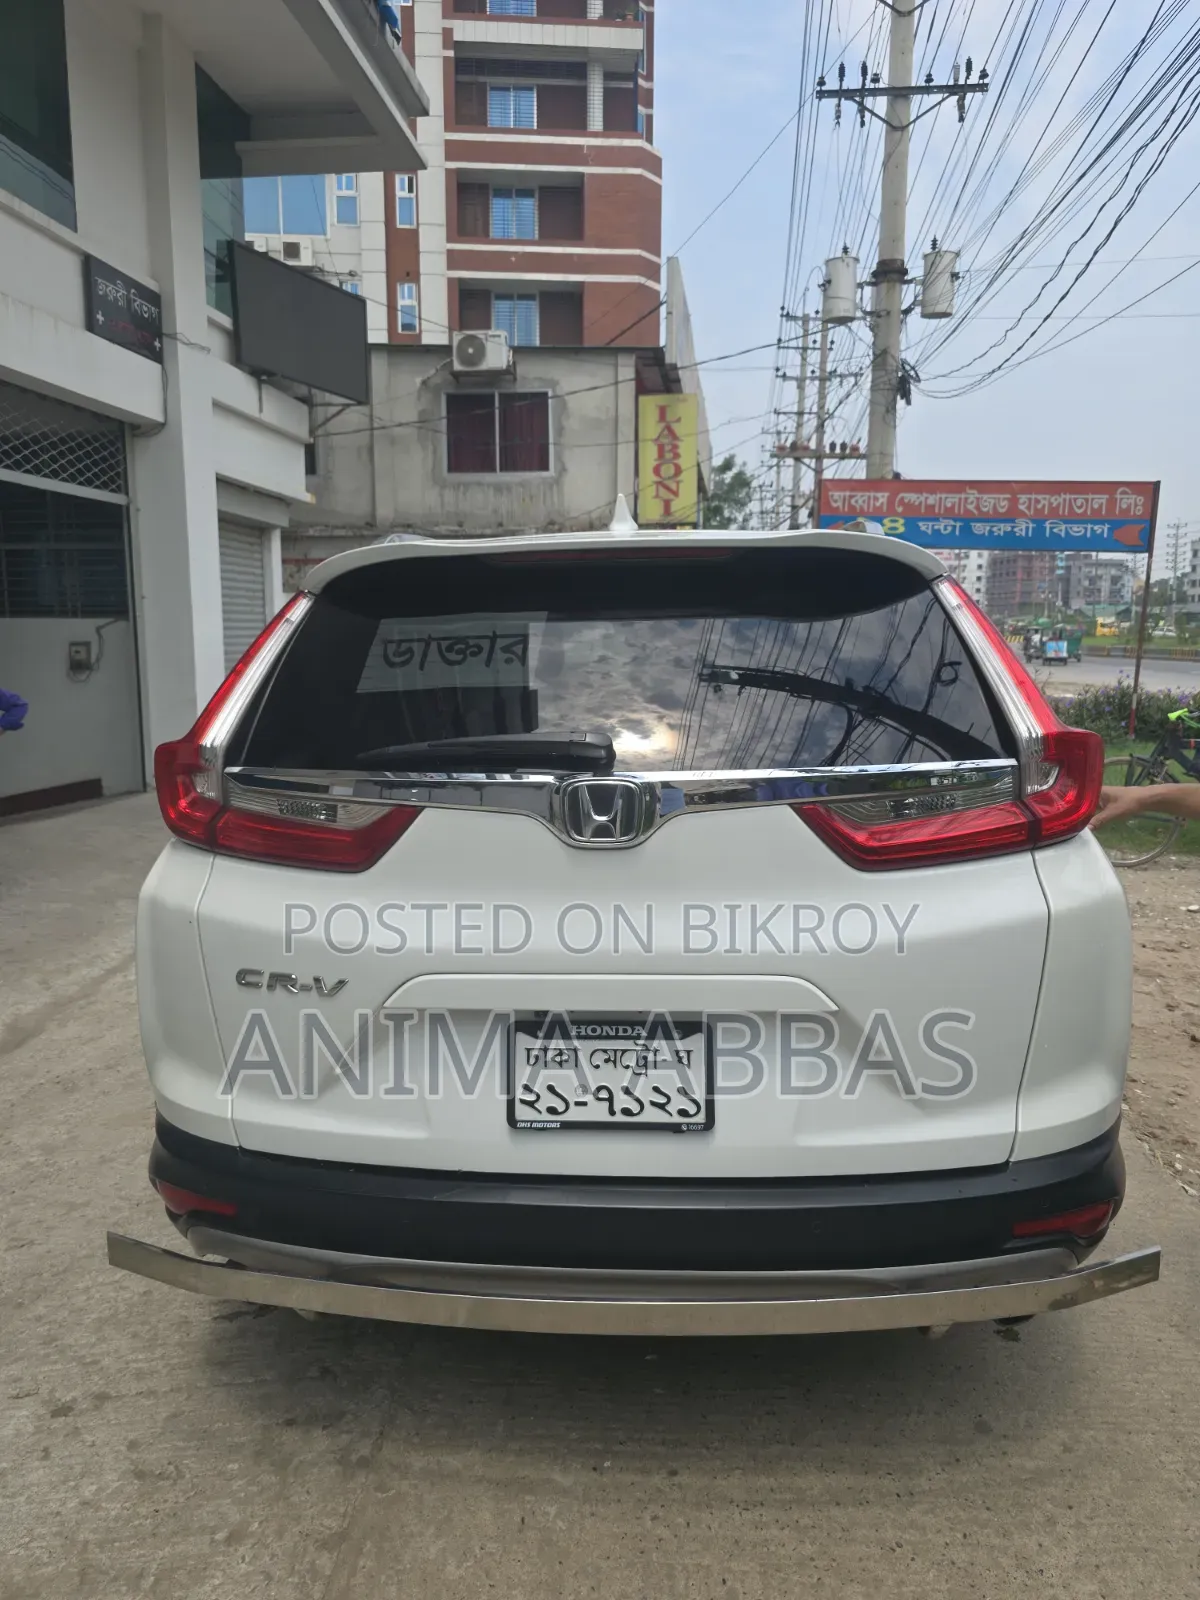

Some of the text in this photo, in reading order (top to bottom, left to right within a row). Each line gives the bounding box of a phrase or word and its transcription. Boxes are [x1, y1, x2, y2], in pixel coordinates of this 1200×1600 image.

[95, 277, 160, 325] জরুরী বিভাগ
[652, 404, 683, 517] LABONI
[828, 490, 890, 513] আব্বাস
[1017, 492, 1109, 516] হাসপাতাল
[970, 518, 1036, 537] জরুরী
[1044, 519, 1111, 538] বিভাগ
[382, 630, 530, 671] ডাক্তার
[235, 967, 349, 998] CR-V
[570, 1025, 647, 1036] HONDA
[525, 1046, 580, 1067] ঢাকা
[518, 1083, 702, 1118] ২১-৭১২১
